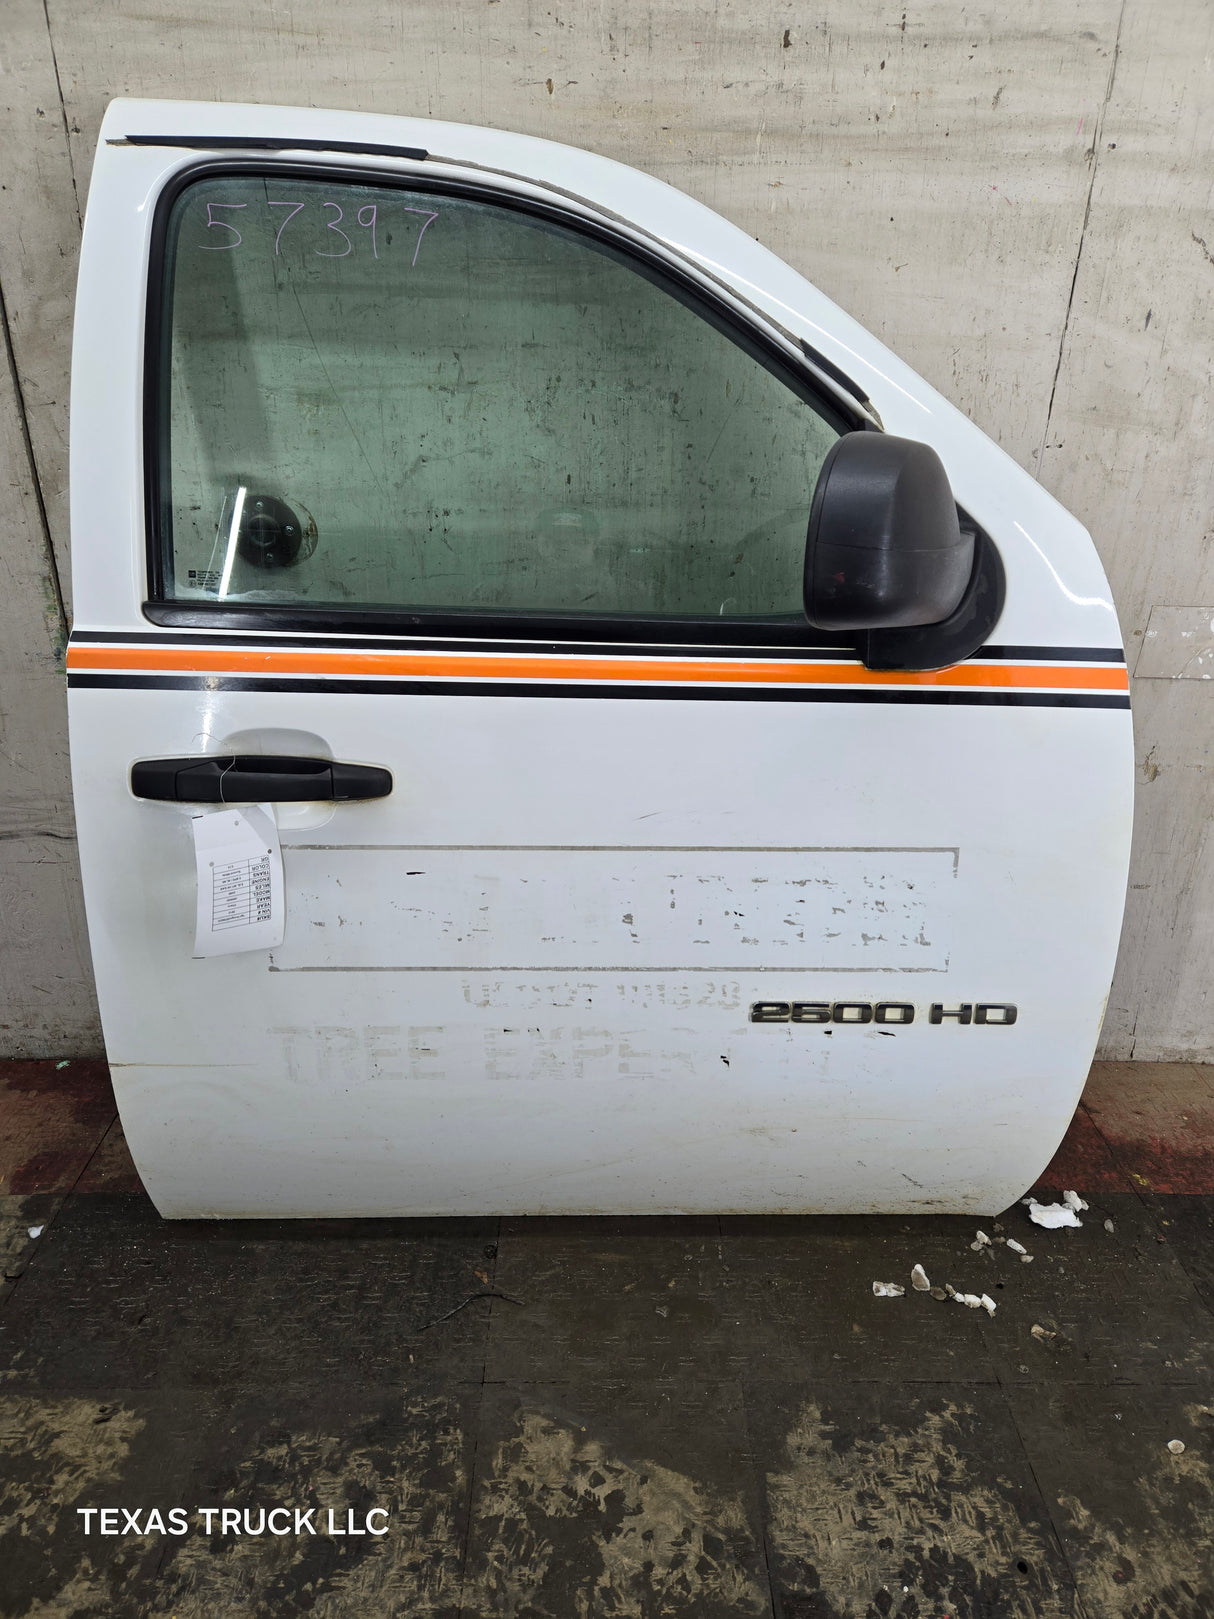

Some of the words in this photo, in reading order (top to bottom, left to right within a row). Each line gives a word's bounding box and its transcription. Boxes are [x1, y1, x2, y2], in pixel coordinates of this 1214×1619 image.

[198, 202, 439, 266] 57397
[750, 1001, 914, 1023] 2500
[929, 1002, 1017, 1025] HD
